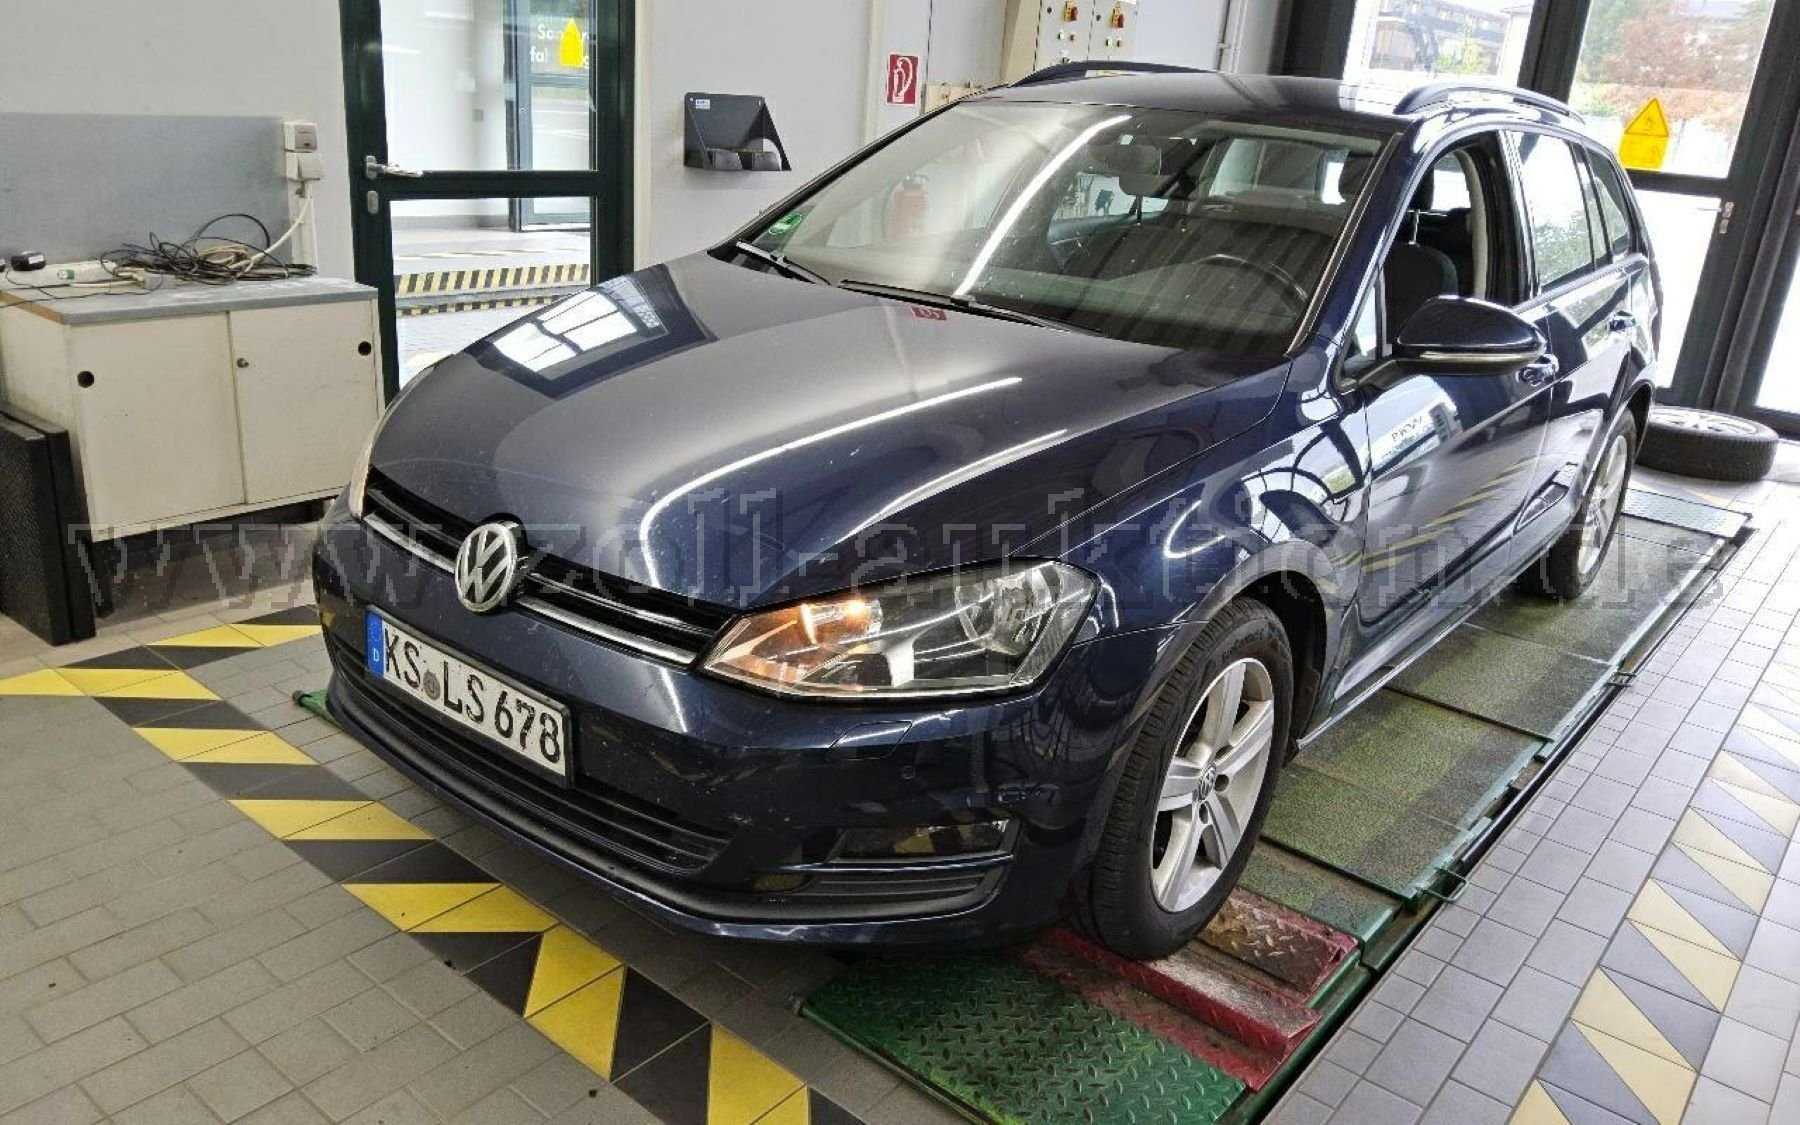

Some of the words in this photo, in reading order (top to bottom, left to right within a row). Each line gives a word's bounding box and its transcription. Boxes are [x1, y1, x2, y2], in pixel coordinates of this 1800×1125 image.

[384, 627, 422, 690] KS
[443, 661, 485, 725] LS
[494, 690, 560, 764] 678
